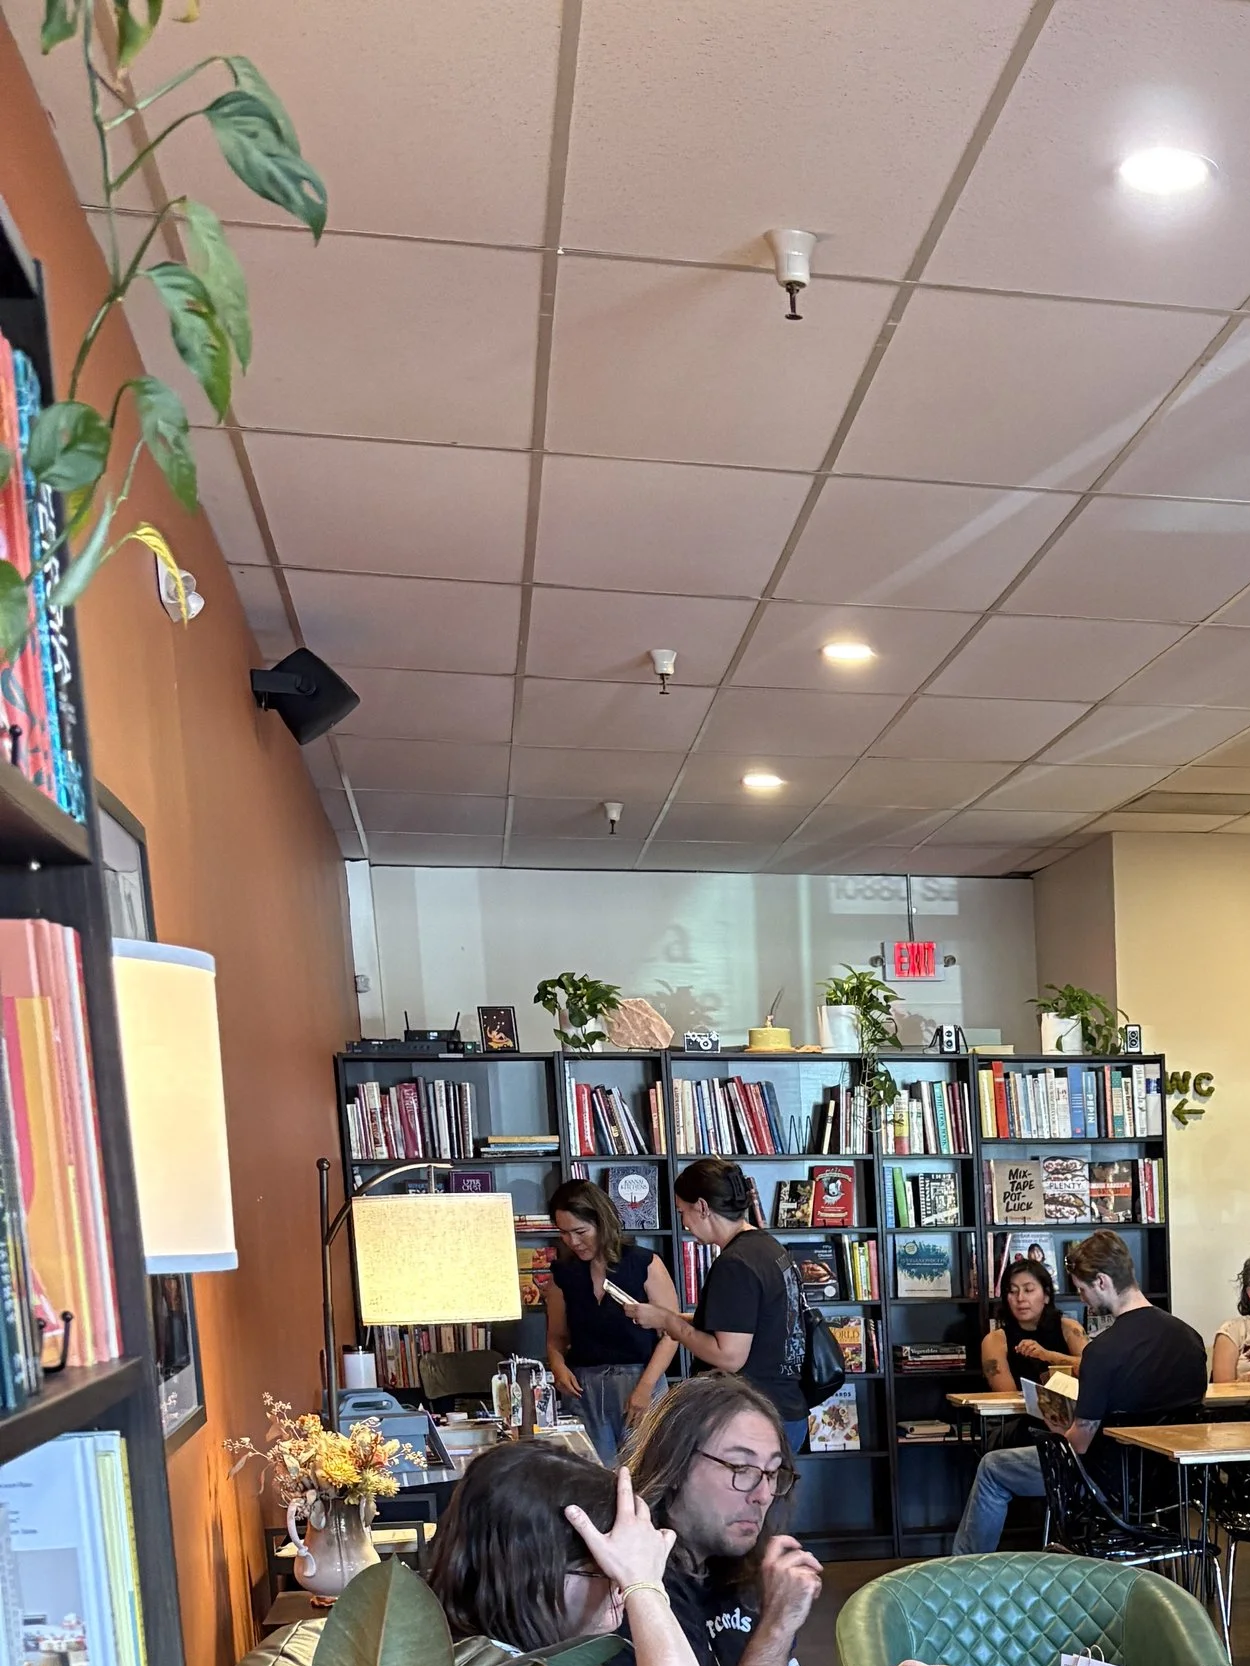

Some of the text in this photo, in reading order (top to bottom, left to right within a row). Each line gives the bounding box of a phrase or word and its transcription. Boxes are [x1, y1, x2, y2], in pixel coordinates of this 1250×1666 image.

[894, 941, 936, 977] EXIT
[1166, 1070, 1215, 1097] WC
[1008, 1168, 1032, 1181] MIX-
[1010, 1180, 1036, 1193] TAPE
[1049, 1182, 1083, 1190] PLENTY
[1003, 1191, 1026, 1203] POT-
[1005, 1202, 1034, 1213] LUCK
